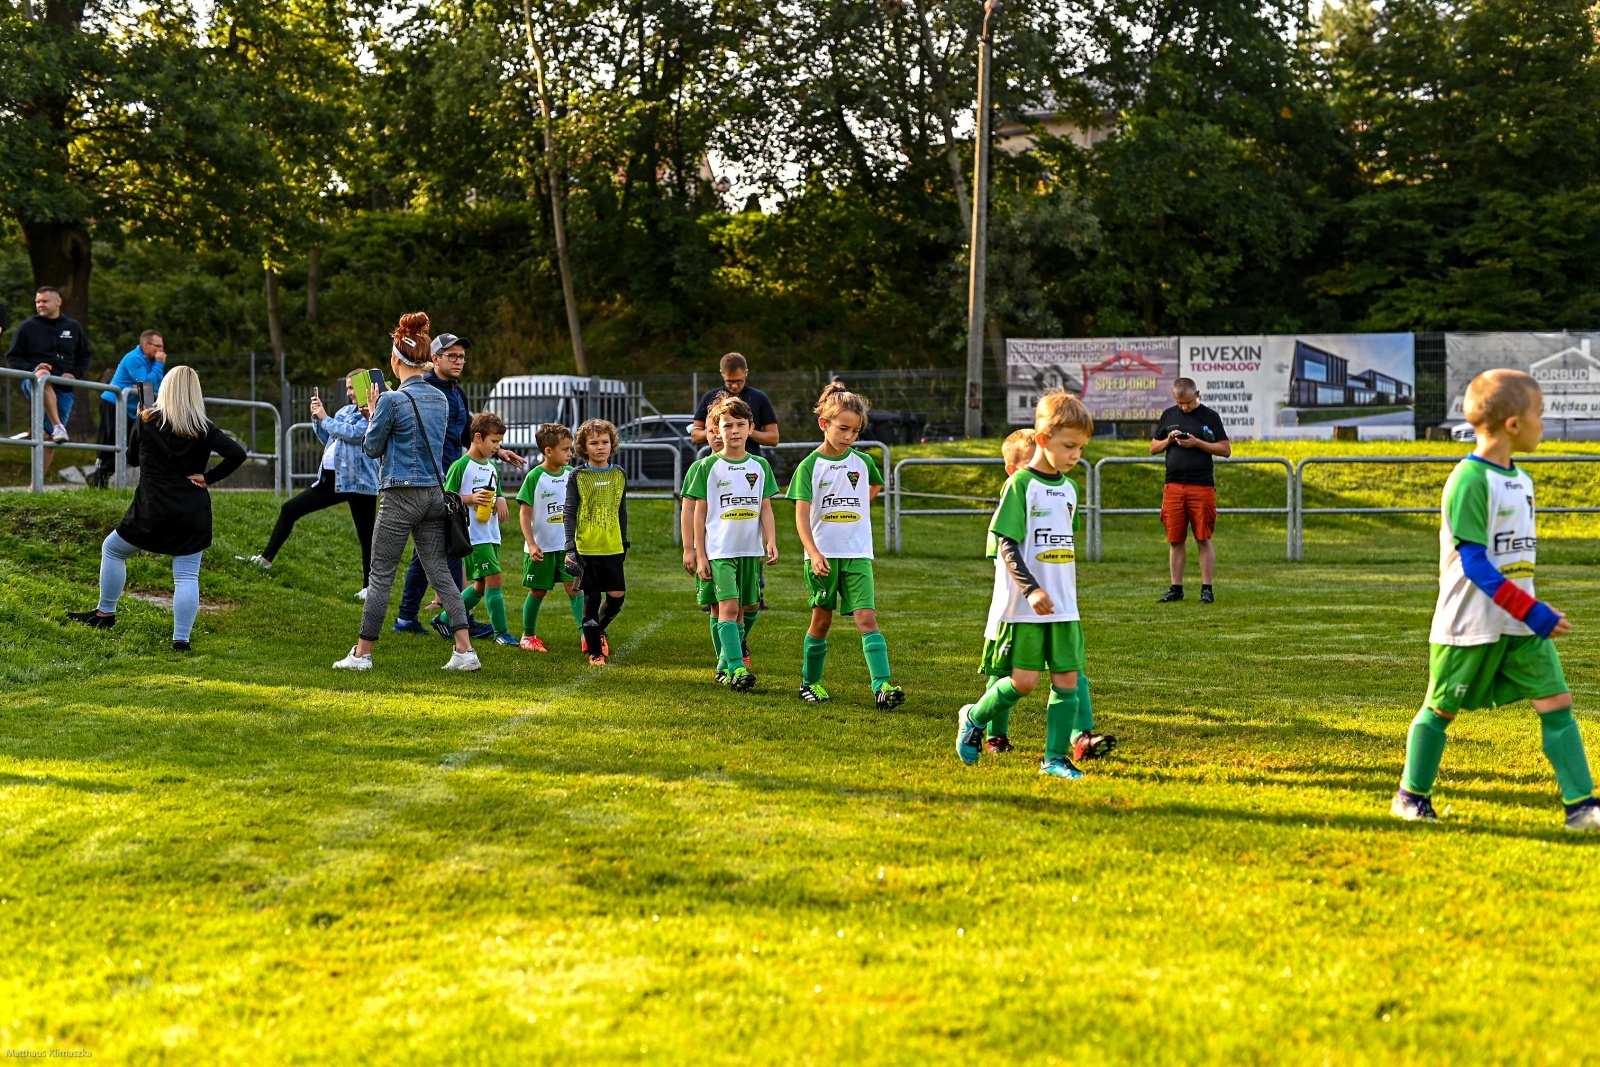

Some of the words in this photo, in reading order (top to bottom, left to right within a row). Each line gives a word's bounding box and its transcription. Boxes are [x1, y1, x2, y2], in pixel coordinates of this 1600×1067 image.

[1190, 346, 1262, 361] PIVEXIN
[1190, 362, 1261, 372] TECHNOLOGY
[1206, 381, 1245, 390] DOSTAWCA
